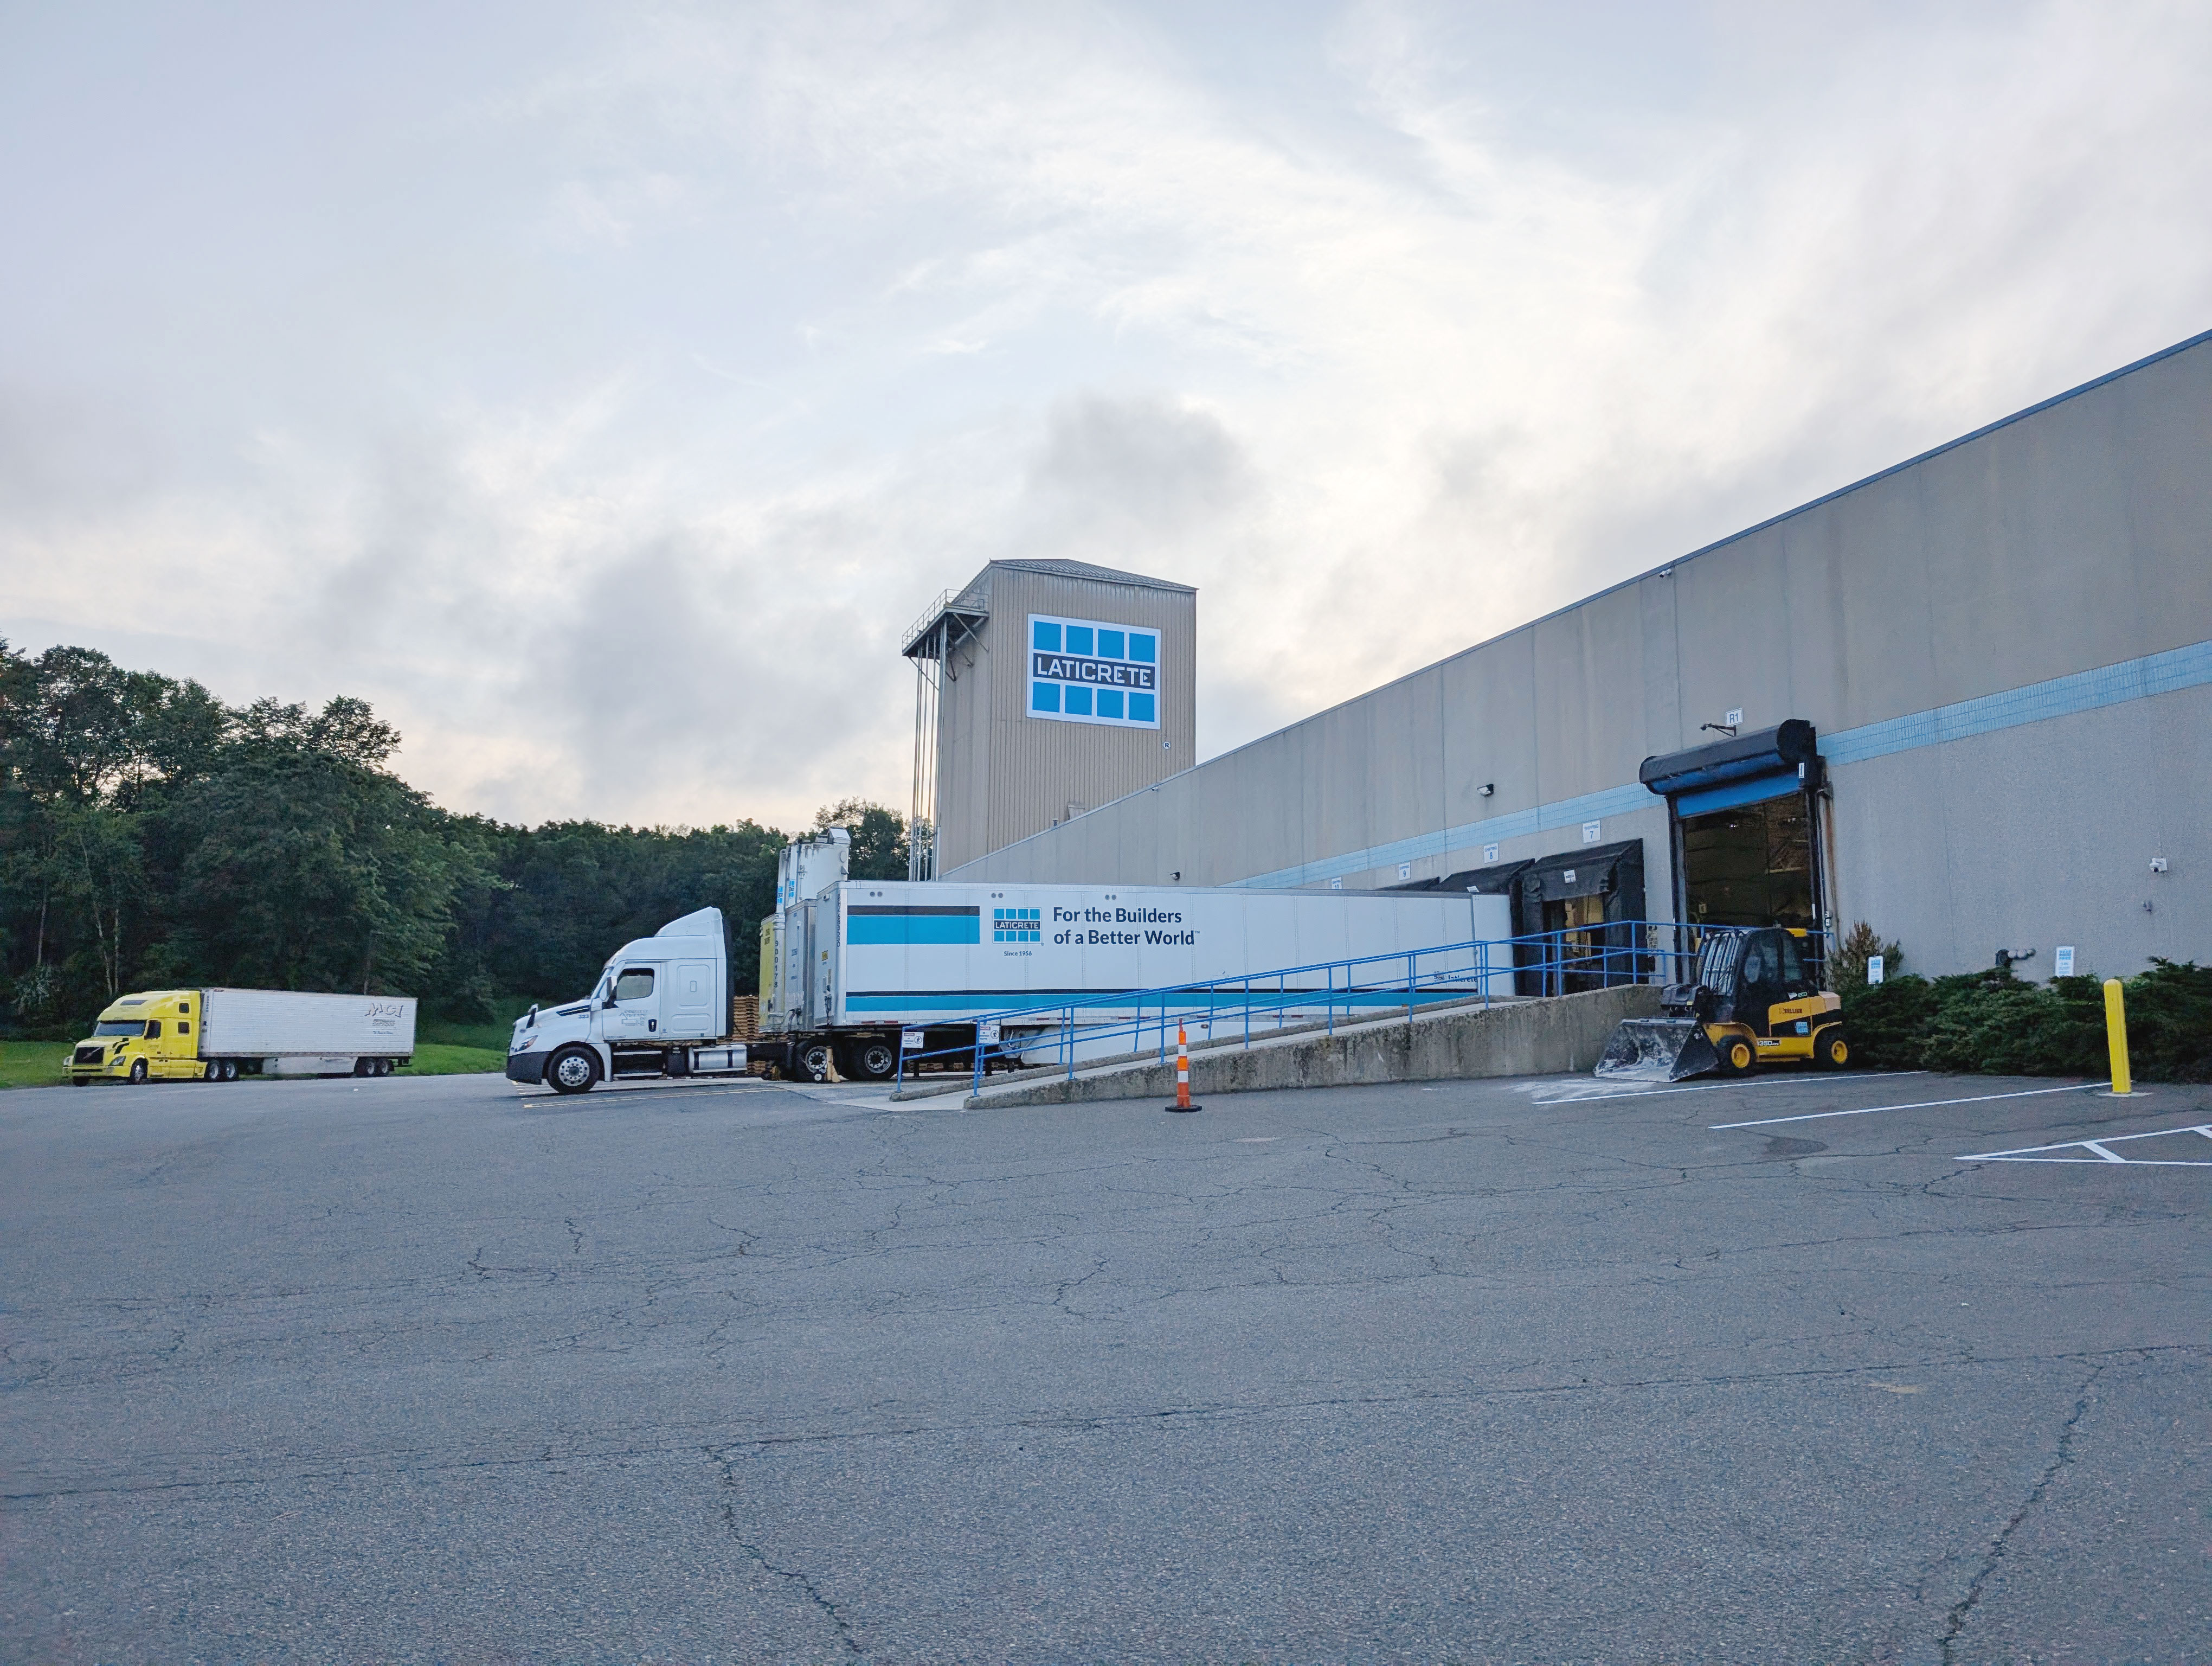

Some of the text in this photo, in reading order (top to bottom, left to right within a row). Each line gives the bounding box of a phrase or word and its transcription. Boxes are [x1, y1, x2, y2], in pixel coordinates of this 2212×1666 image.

[1037, 657, 1151, 687] LATICRETE
[1729, 713, 1738, 723] R1
[1590, 830, 1594, 839] 7
[1489, 851, 1493, 860] 8
[1053, 907, 1182, 923] For the Builders
[1053, 929, 1071, 945] of
[1075, 933, 1084, 945] a
[1088, 930, 1141, 945] Better
